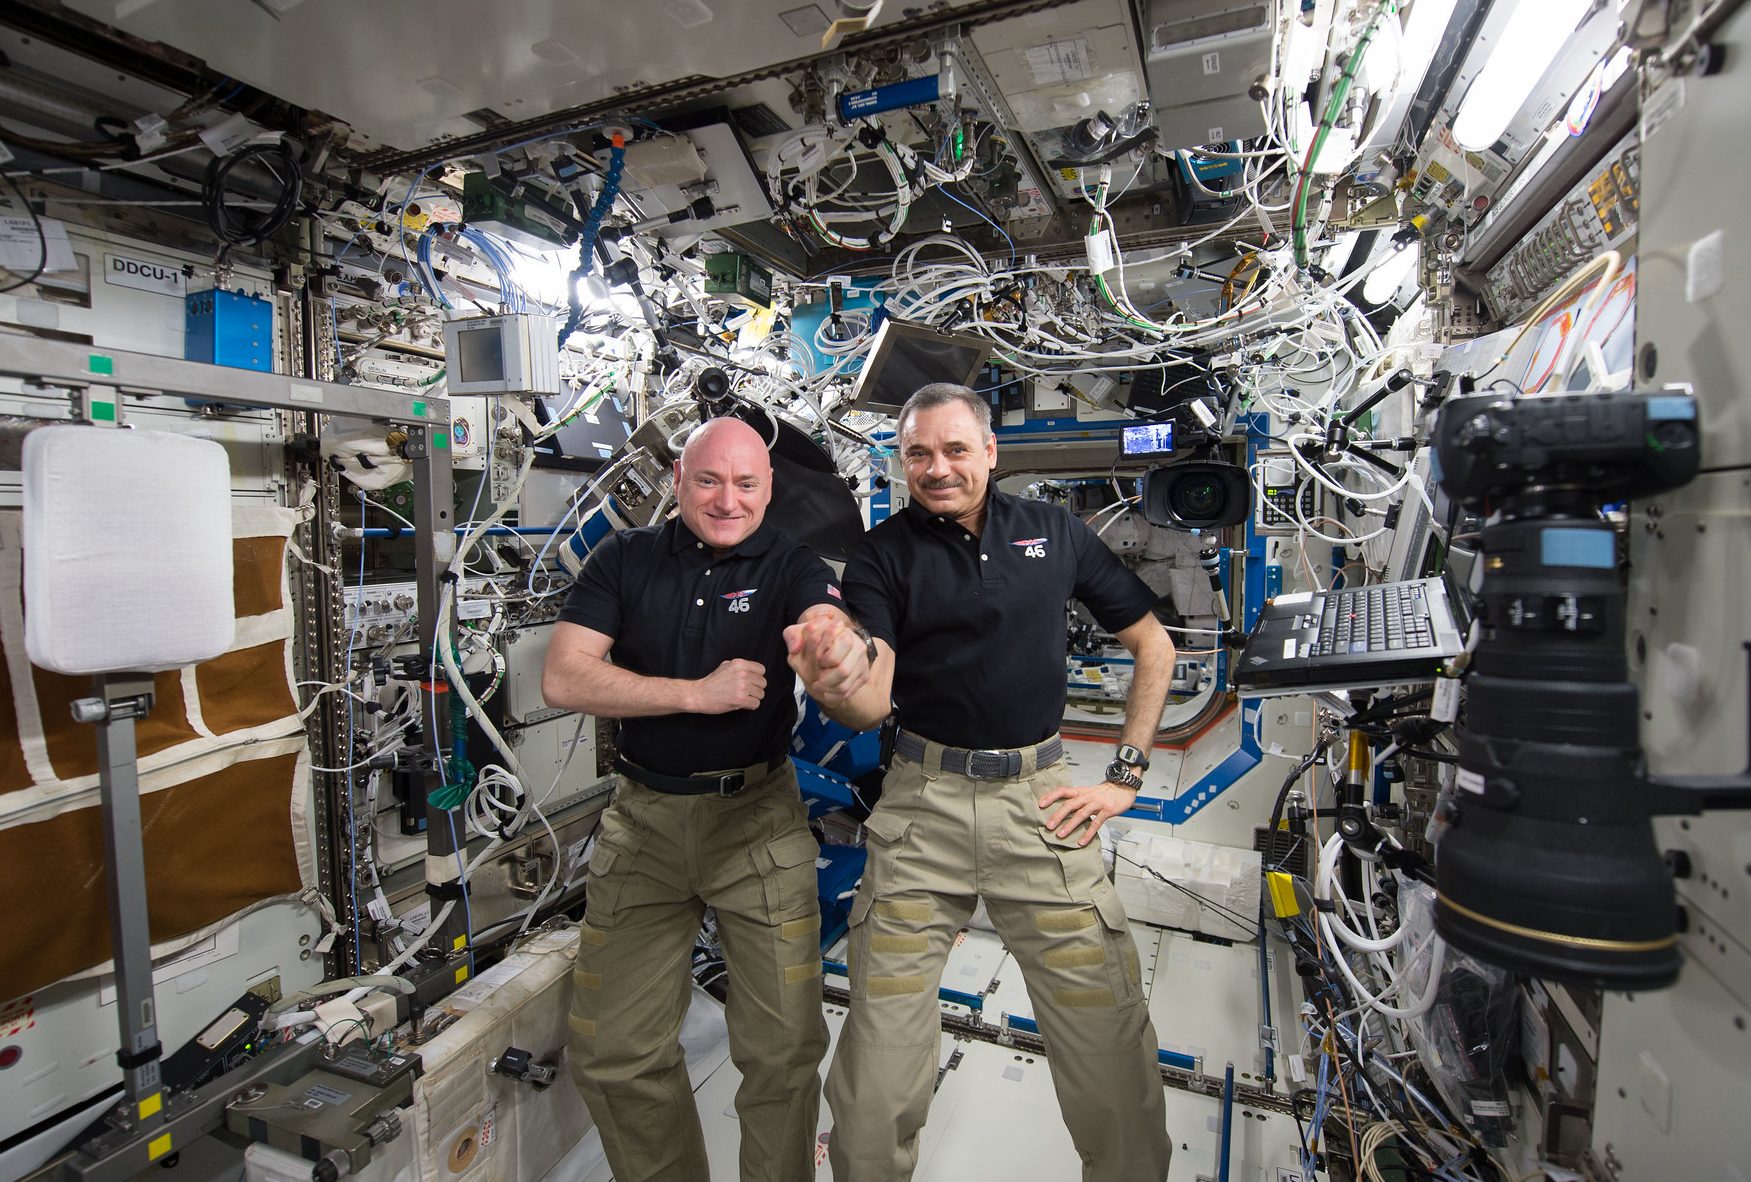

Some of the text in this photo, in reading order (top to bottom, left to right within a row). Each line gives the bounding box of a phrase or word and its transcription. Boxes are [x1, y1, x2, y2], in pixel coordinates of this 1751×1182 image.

[113, 258, 178, 284] DDCU-1
[336, 265, 357, 282] EXP
[1024, 544, 1046, 558] 46
[728, 597, 750, 613] 46
